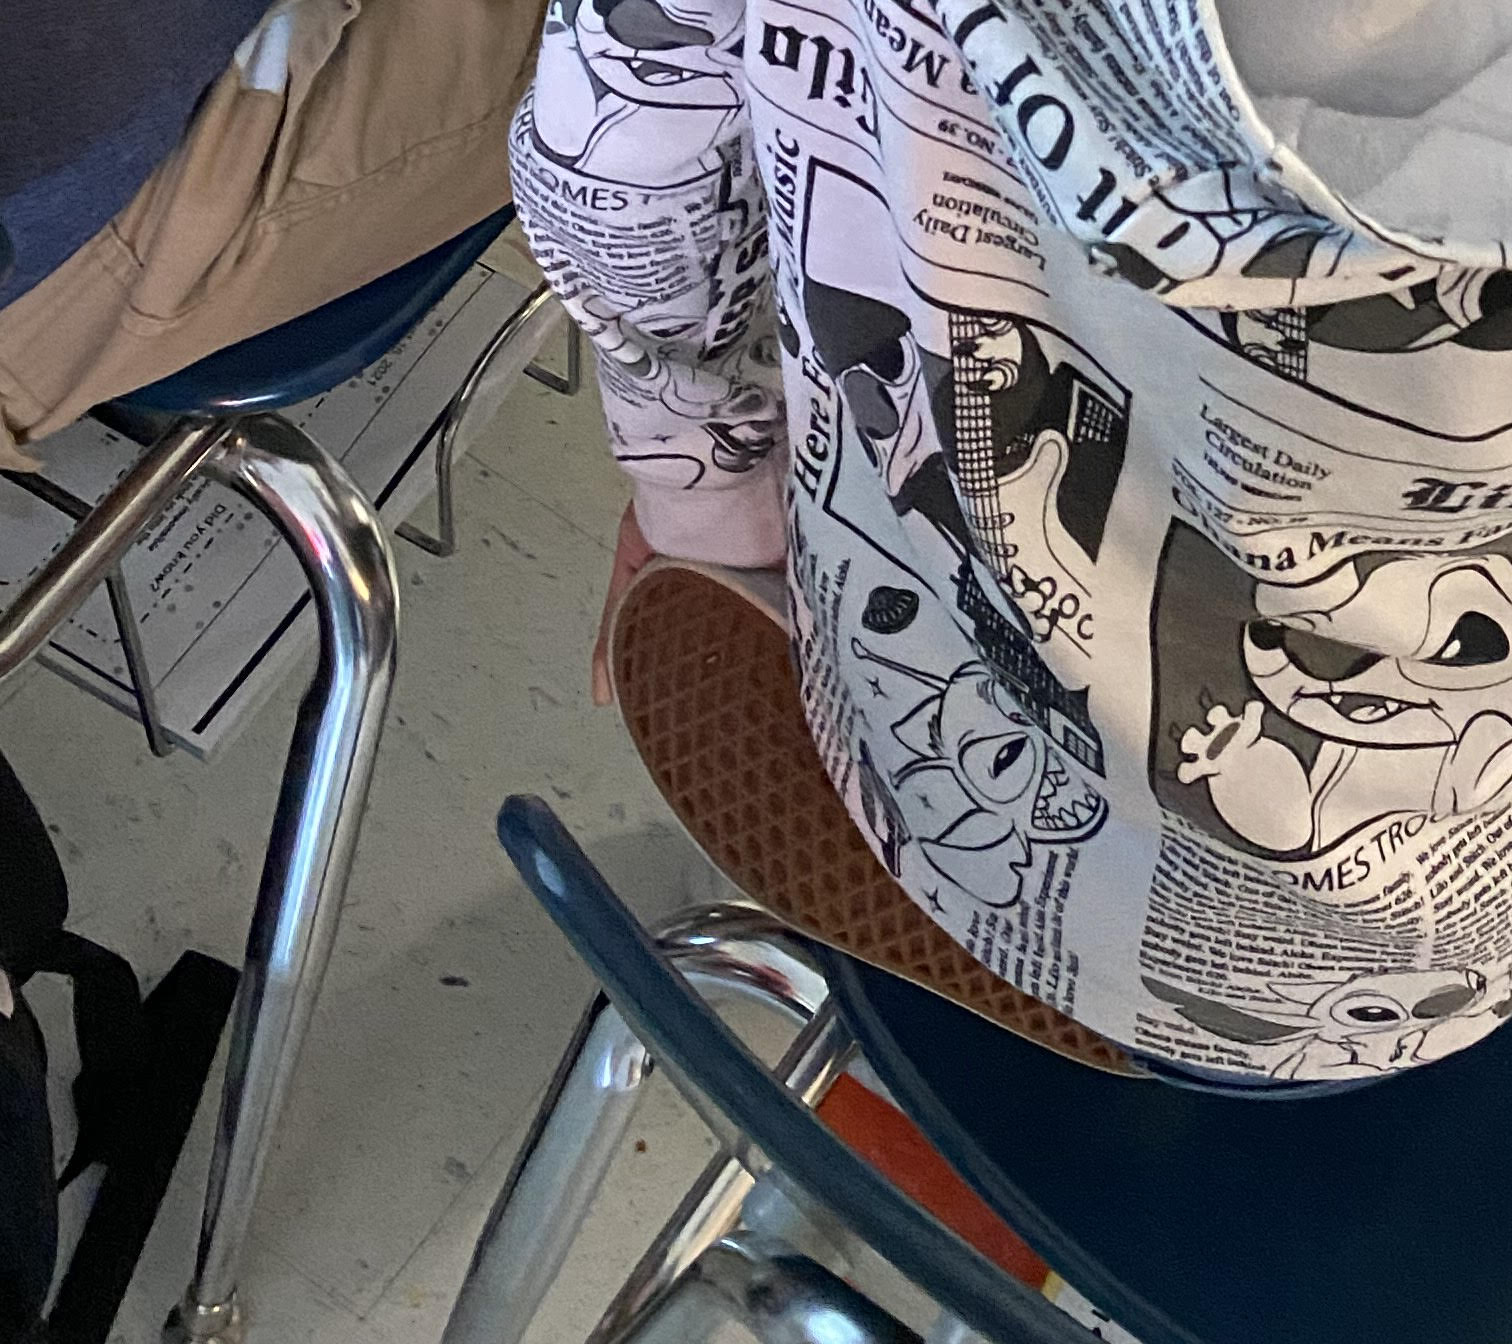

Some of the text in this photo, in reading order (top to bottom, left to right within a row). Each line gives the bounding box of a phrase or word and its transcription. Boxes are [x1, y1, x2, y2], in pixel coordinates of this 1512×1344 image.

[910, 205, 972, 244] Daily
[926, 192, 1044, 246] Circulation
[1200, 402, 1269, 460] Largest
[1273, 450, 1331, 480] Daily
[1205, 428, 1312, 490] Circulation
